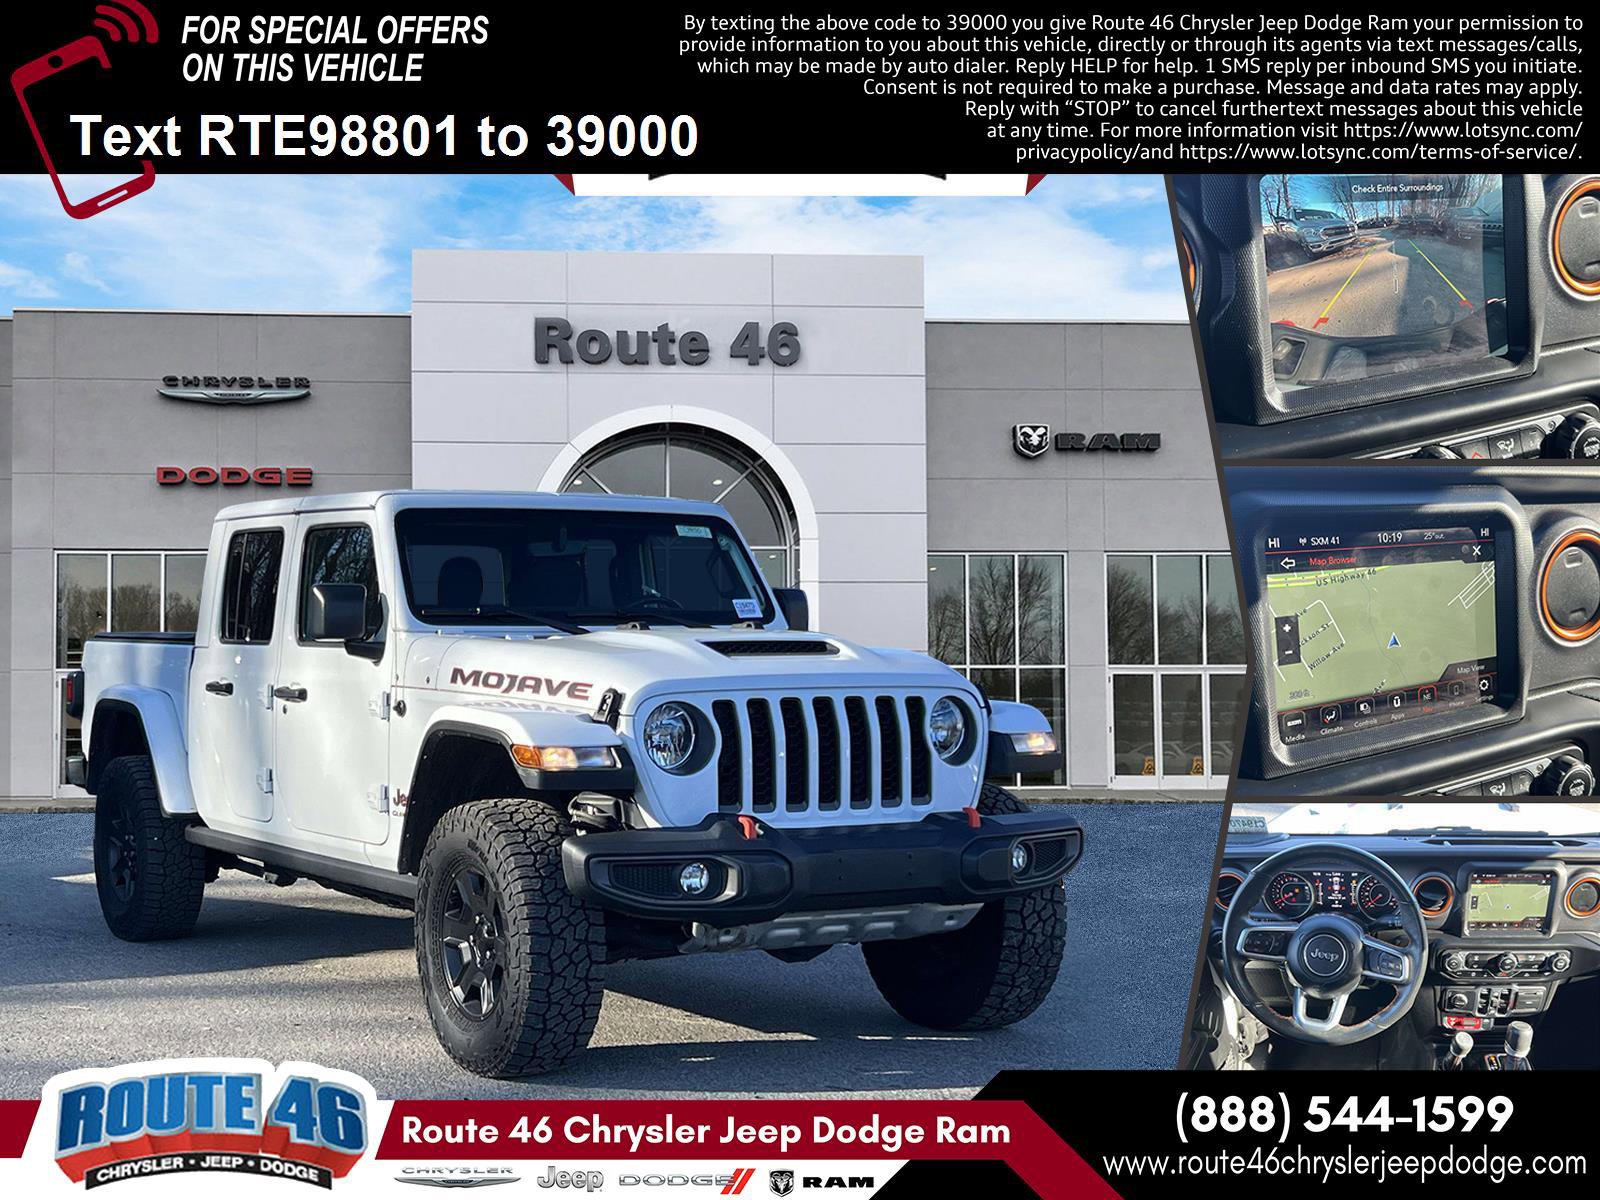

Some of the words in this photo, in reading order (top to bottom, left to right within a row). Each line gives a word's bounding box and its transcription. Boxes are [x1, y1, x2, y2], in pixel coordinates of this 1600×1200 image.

[1352, 184, 1376, 193] Check
[1377, 184, 1398, 193] Entire
[1400, 183, 1444, 192] Surroundings
[534, 317, 710, 366] Route
[730, 321, 802, 367] 46
[161, 374, 311, 389] CHRYSLER
[1055, 432, 1162, 452] RAM
[156, 466, 314, 487] DODGE
[1269, 538, 1280, 548] HI
[1311, 537, 1329, 546] SXM
[1331, 536, 1341, 545] 41
[1378, 532, 1402, 544] 10:19
[1309, 556, 1327, 566] Map
[1328, 556, 1357, 565] Browser
[1316, 578, 1328, 587] US
[1330, 571, 1364, 584] Highway
[1367, 568, 1377, 576] 46
[1308, 652, 1331, 670] Willow
[450, 667, 594, 701] MOJAVE
[1310, 948, 1340, 962] Jeep
